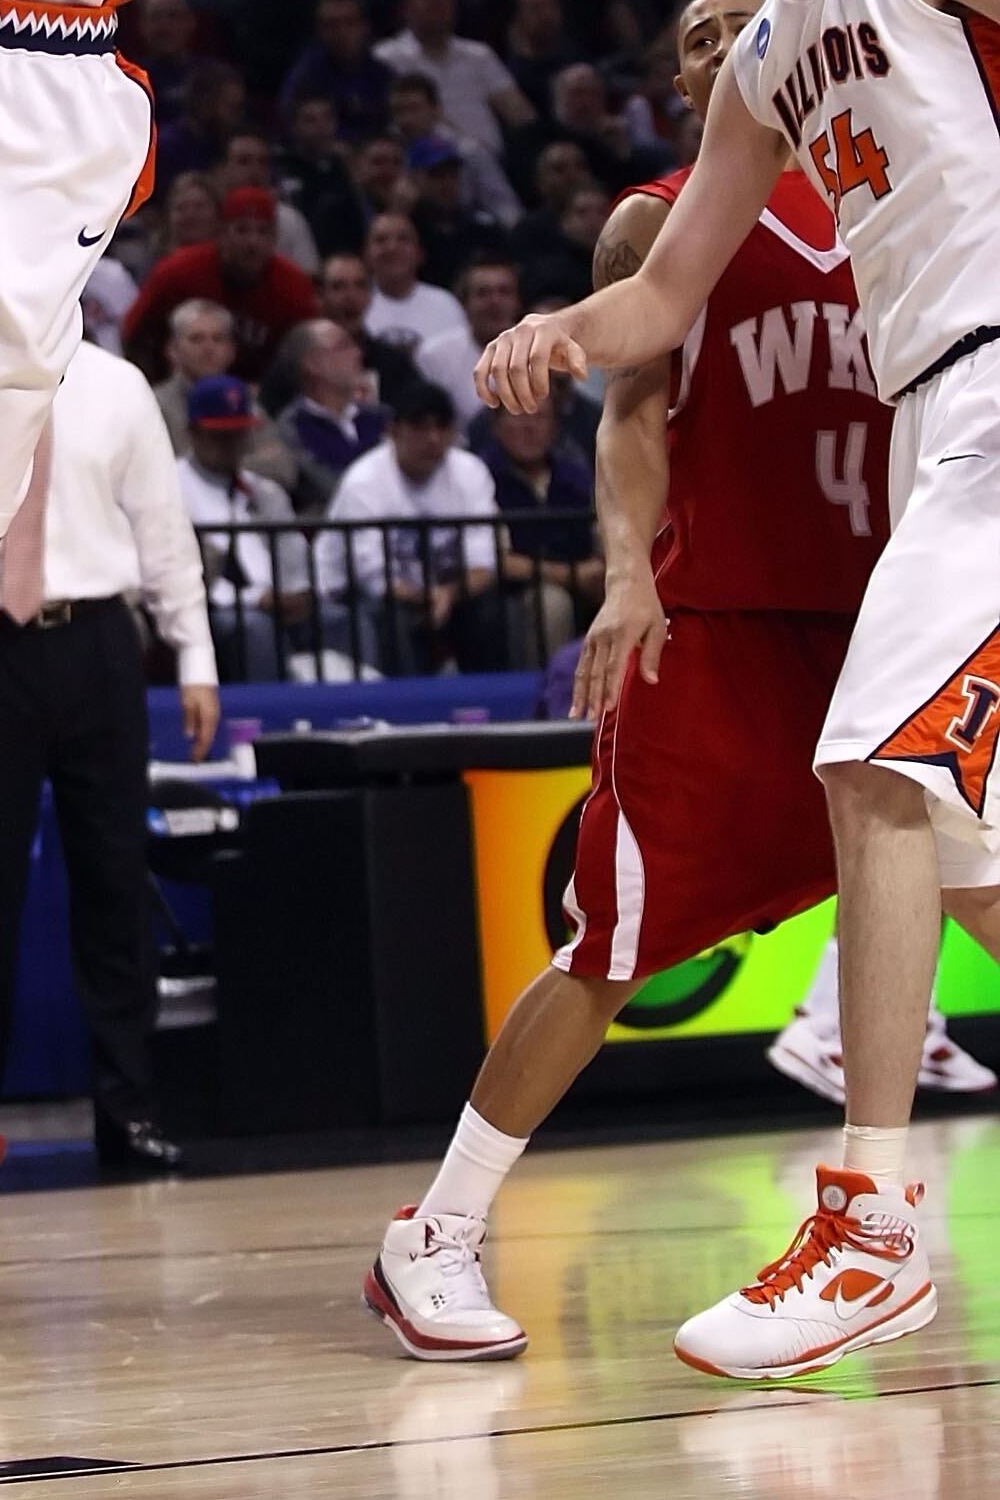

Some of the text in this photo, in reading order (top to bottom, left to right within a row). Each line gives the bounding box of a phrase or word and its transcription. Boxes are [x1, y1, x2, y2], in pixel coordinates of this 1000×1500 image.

[771, 21, 892, 151] ILLIOIS
[729, 300, 878, 408] WK
[814, 421, 873, 536] 4
